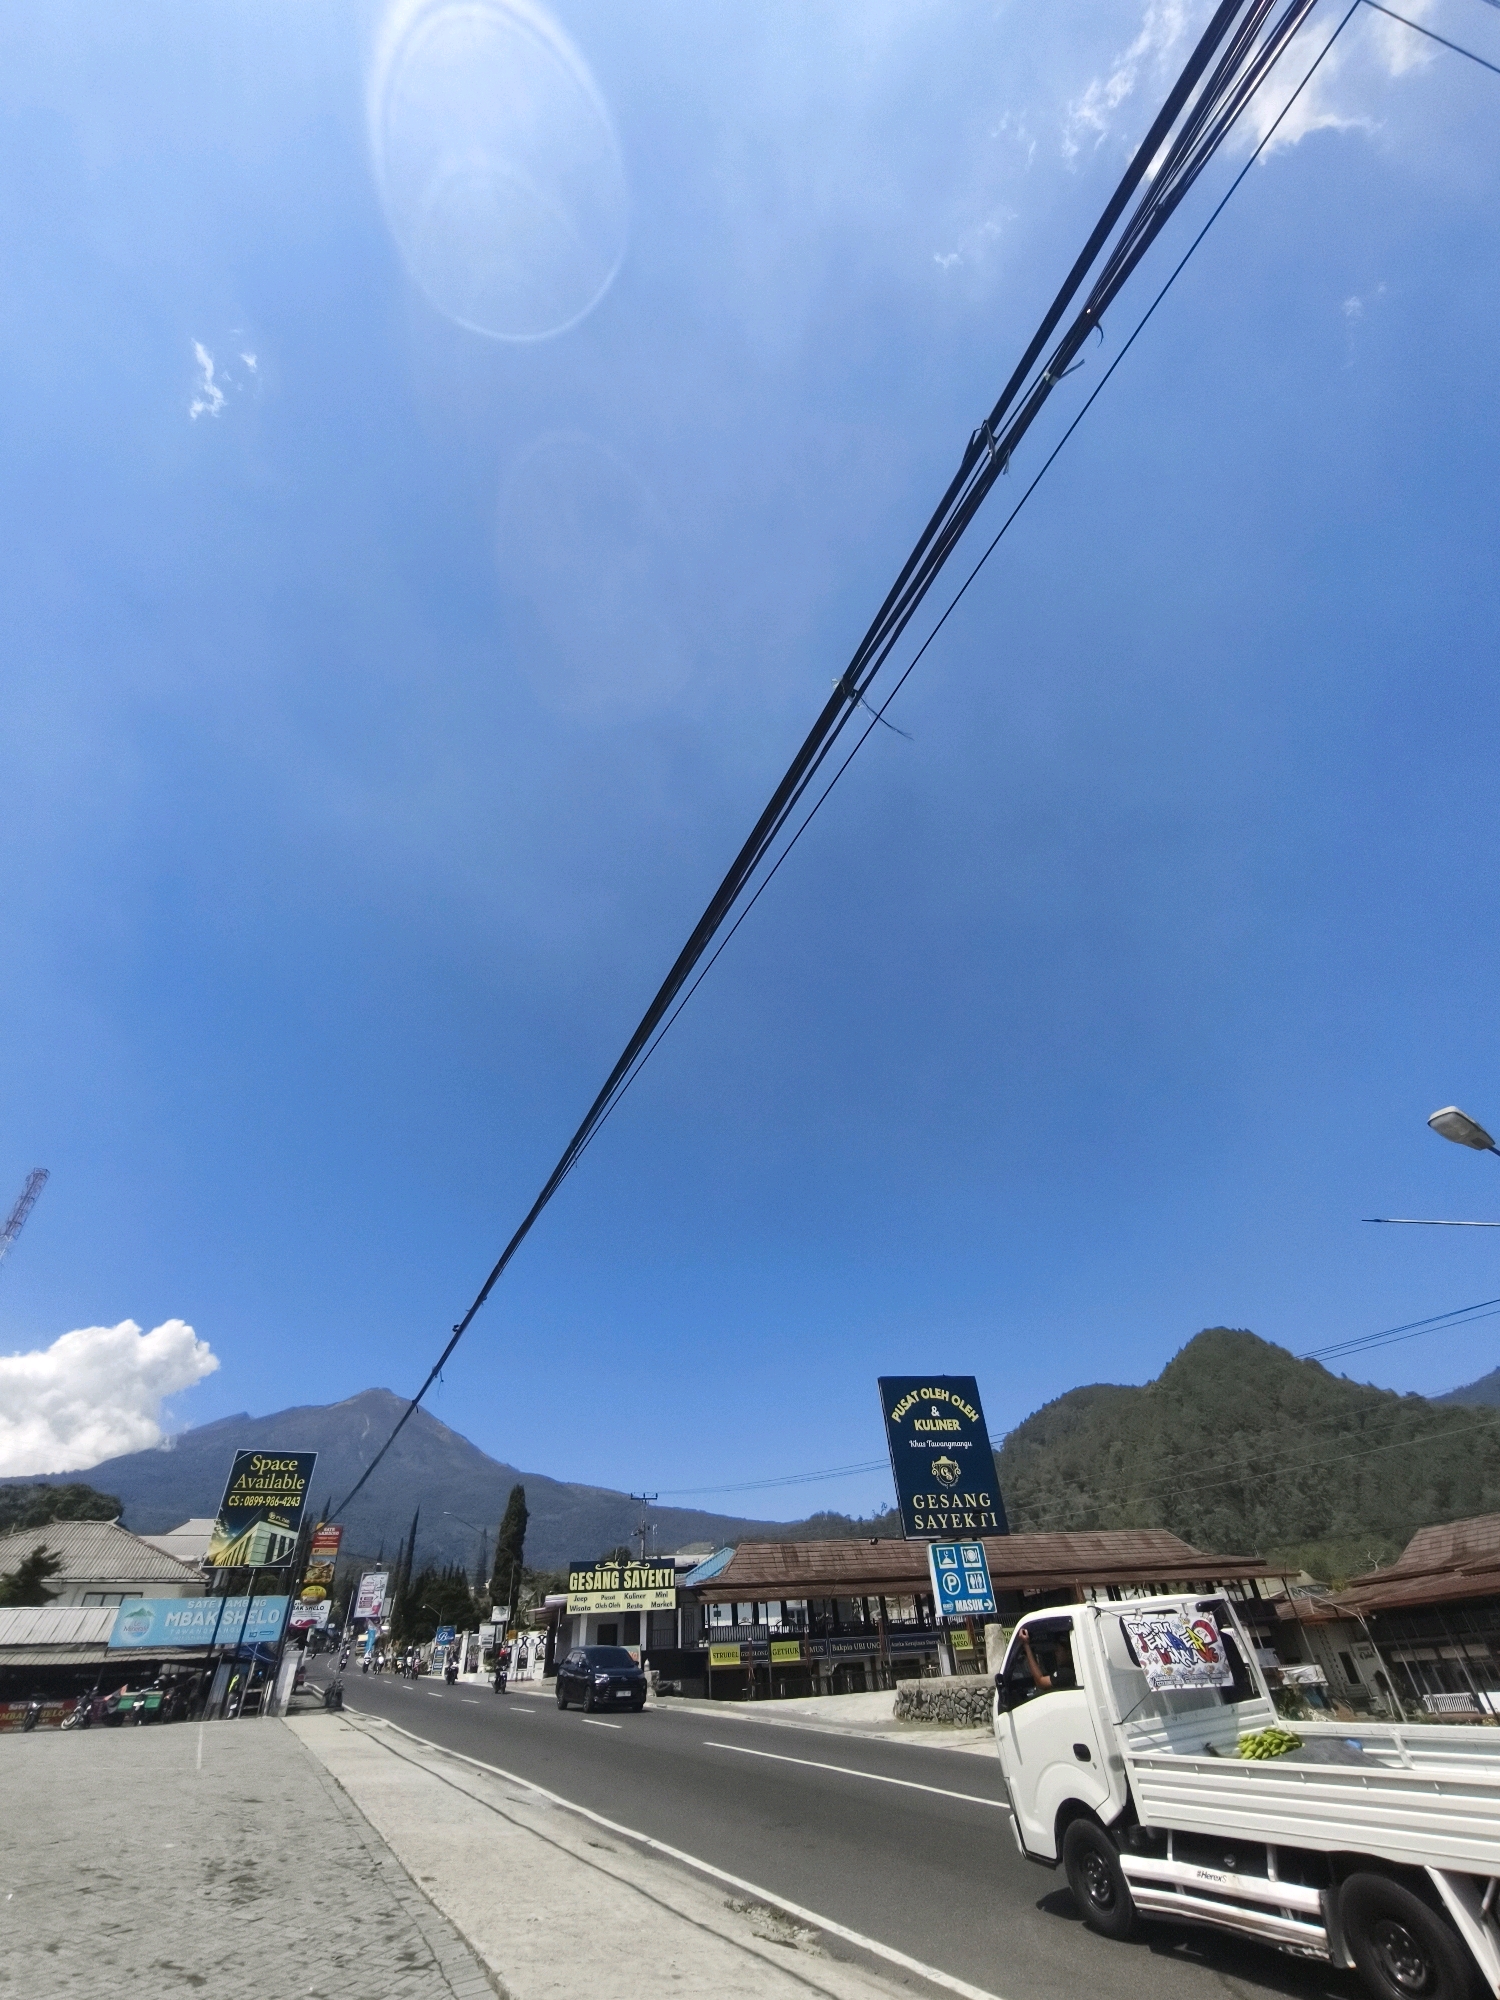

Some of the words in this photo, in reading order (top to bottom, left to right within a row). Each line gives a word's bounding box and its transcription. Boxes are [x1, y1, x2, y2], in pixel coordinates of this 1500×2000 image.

[891, 1390, 920, 1423] PUSAT
[920, 1387, 950, 1402] OLEH
[951, 1394, 980, 1422] OLEH
[930, 1405, 940, 1417] &
[913, 1419, 962, 1431] KULINER
[908, 1440, 926, 1448] Khas
[926, 1439, 973, 1450] Tawangmangu
[250, 1454, 298, 1475] Space
[233, 1473, 306, 1490] Available
[912, 1492, 991, 1509] GESANG
[914, 1511, 998, 1530] SAYEKTI
[569, 1571, 620, 1591] GESANG
[623, 1568, 675, 1589] SAYEKTI
[573, 1595, 588, 1603] Jeep
[624, 1592, 647, 1600] Kuliner
[188, 1600, 216, 1609] SATE
[954, 1598, 985, 1612] MASUK
[164, 1611, 220, 1627] MBAK
[222, 1609, 281, 1625] SHELO
[712, 1651, 739, 1659] STRUDEL
[772, 1646, 800, 1656] GETHUK
